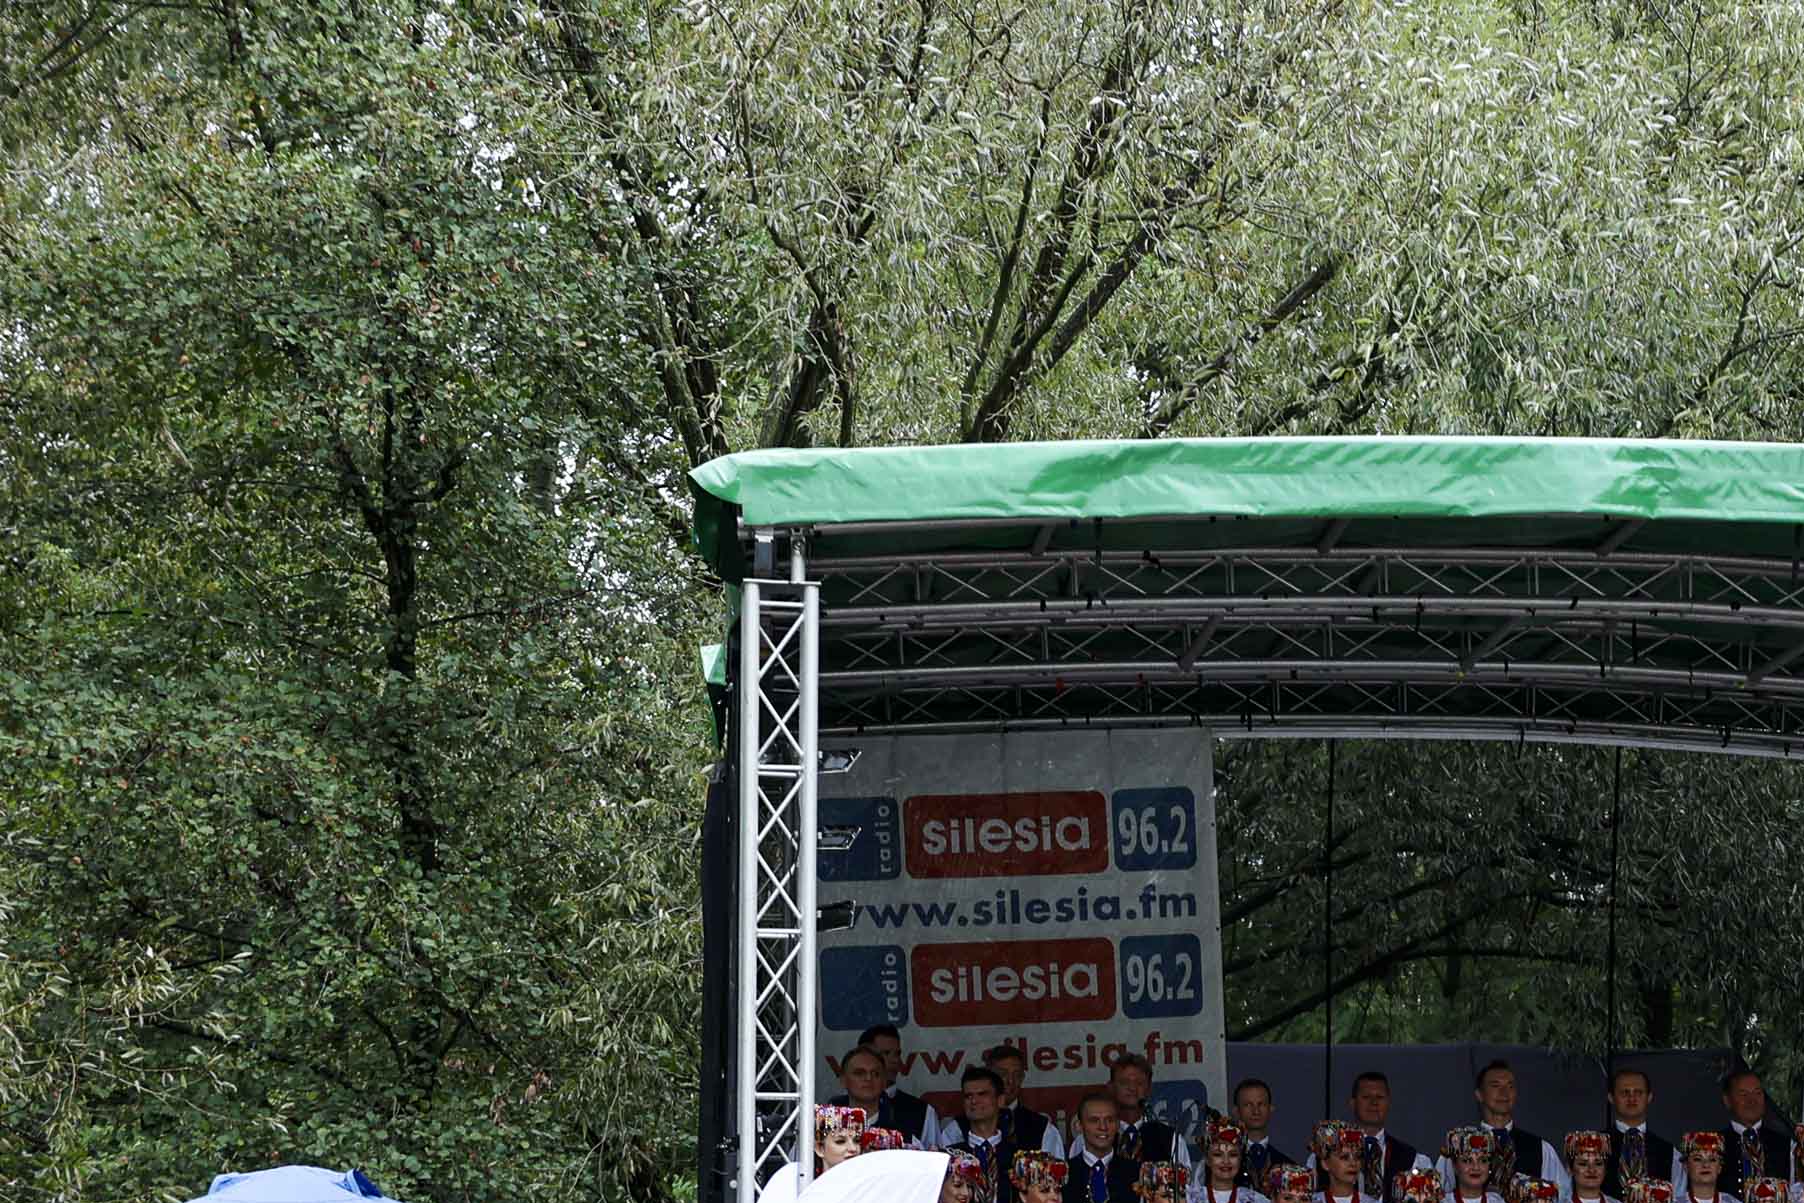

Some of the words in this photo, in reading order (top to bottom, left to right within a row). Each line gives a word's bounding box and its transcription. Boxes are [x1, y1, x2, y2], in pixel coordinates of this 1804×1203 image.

[875, 805, 892, 873] radio
[922, 815, 1091, 855] silesia
[1118, 805, 1189, 856] 96.2
[881, 953, 898, 1022] radio
[930, 962, 1100, 1003] silesia
[1126, 952, 1195, 1003] 96.2
